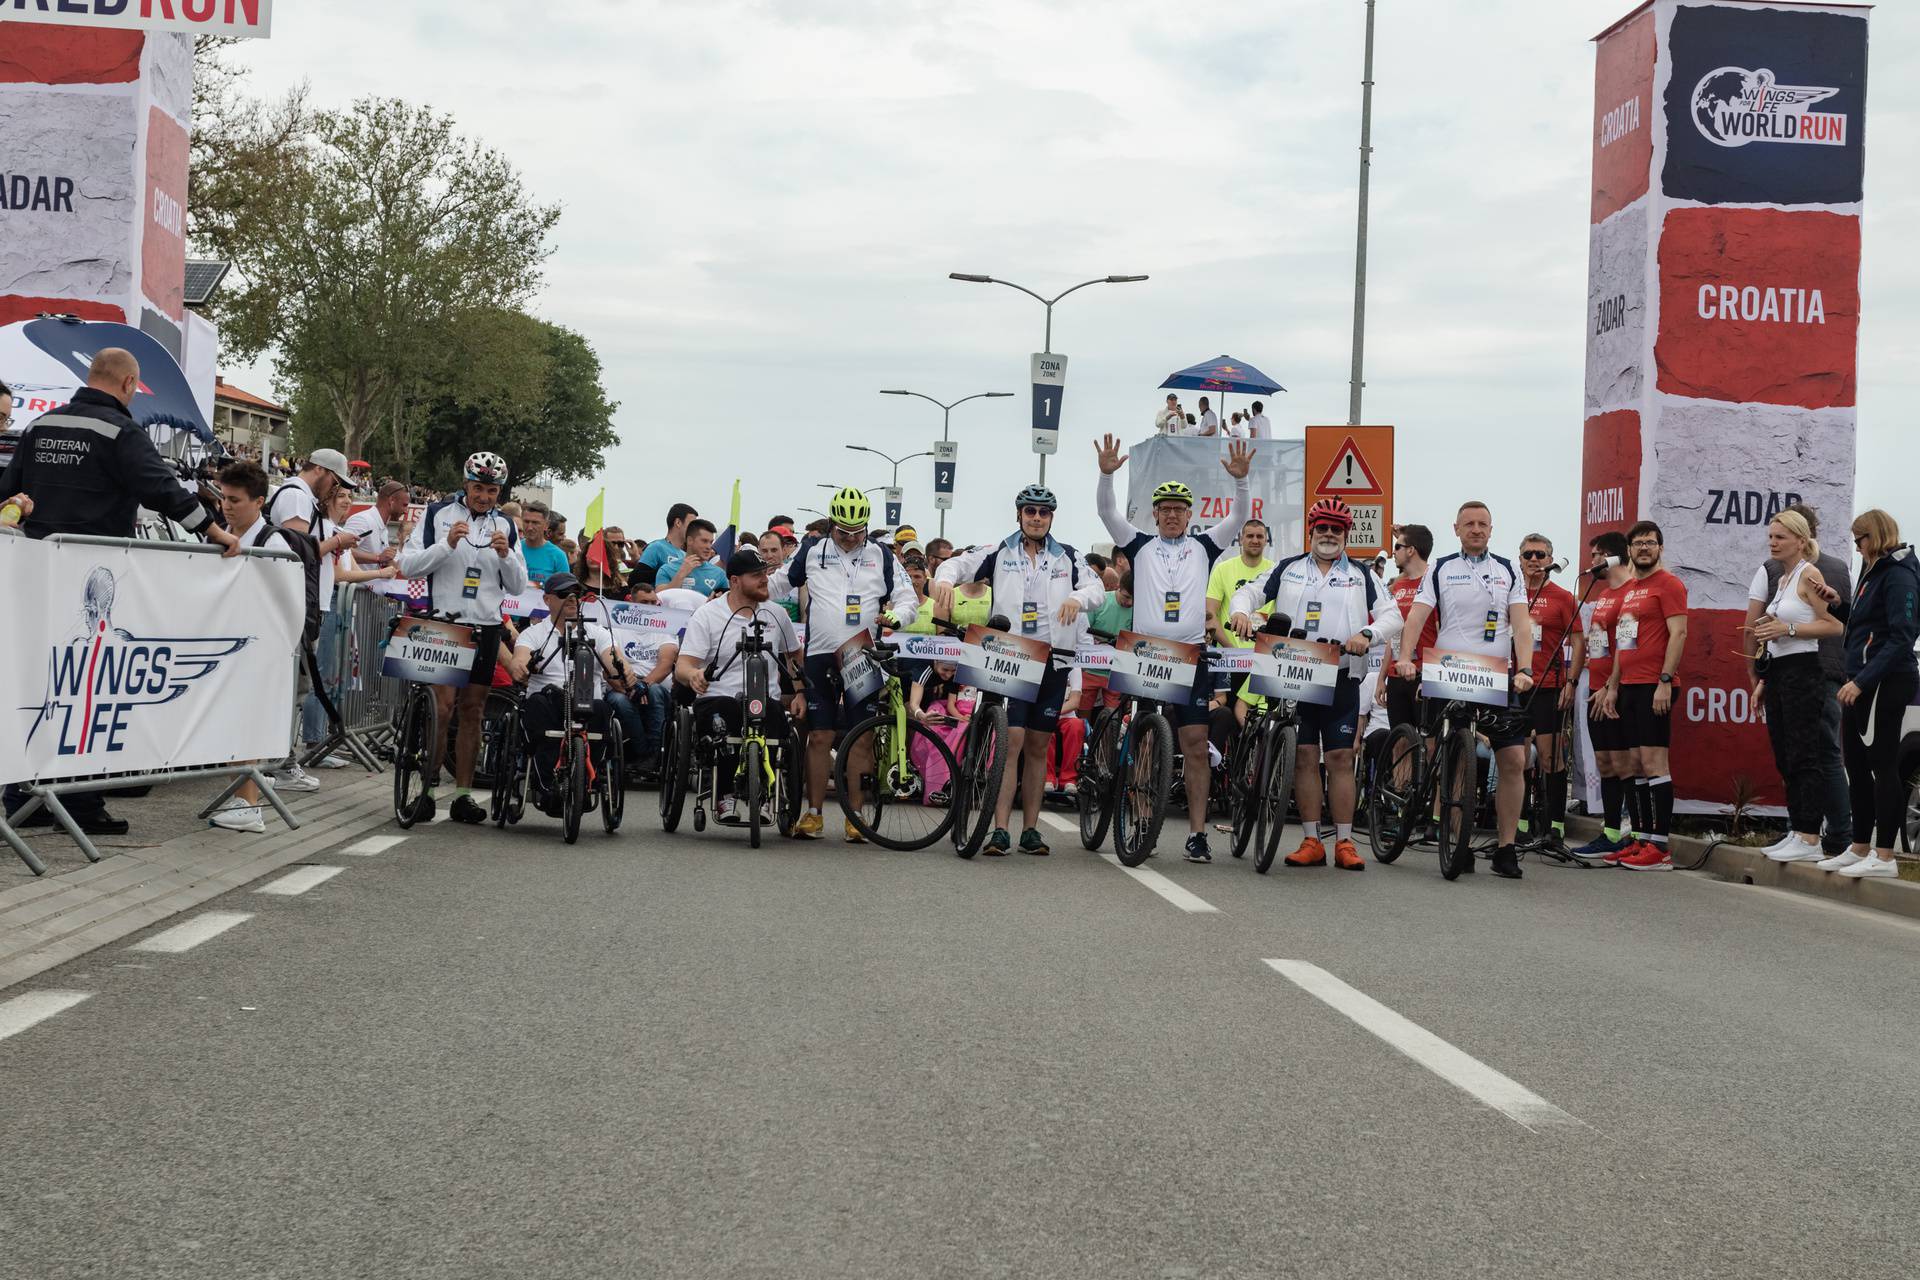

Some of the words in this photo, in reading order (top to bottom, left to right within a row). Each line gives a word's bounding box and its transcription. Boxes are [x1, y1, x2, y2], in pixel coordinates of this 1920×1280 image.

[1743, 88, 1796, 103] WINGS
[1749, 101, 1780, 113] LIFE
[1600, 96, 1640, 149] CROATIA
[153, 187, 182, 240] CROATIA
[1698, 283, 1826, 325] CROATIA
[1596, 294, 1626, 336] ZADAR
[1040, 361, 1060, 370] ZONA
[1044, 398, 1051, 416] 1
[34, 452, 84, 465] SECURITY
[941, 471, 948, 484] 2
[890, 509, 897, 519] 2
[1587, 487, 1625, 526] CROATIA
[402, 645, 459, 666] 1.WOMAN
[52, 645, 171, 697] WINGS
[984, 656, 1020, 677] 1.MAN
[1137, 662, 1172, 681] 1.MAN
[1277, 663, 1313, 681] 1.MAN
[1142, 680, 1159, 689] ZADAR
[1438, 670, 1494, 688] 1.WOMAN
[58, 703, 133, 755] LIFE
